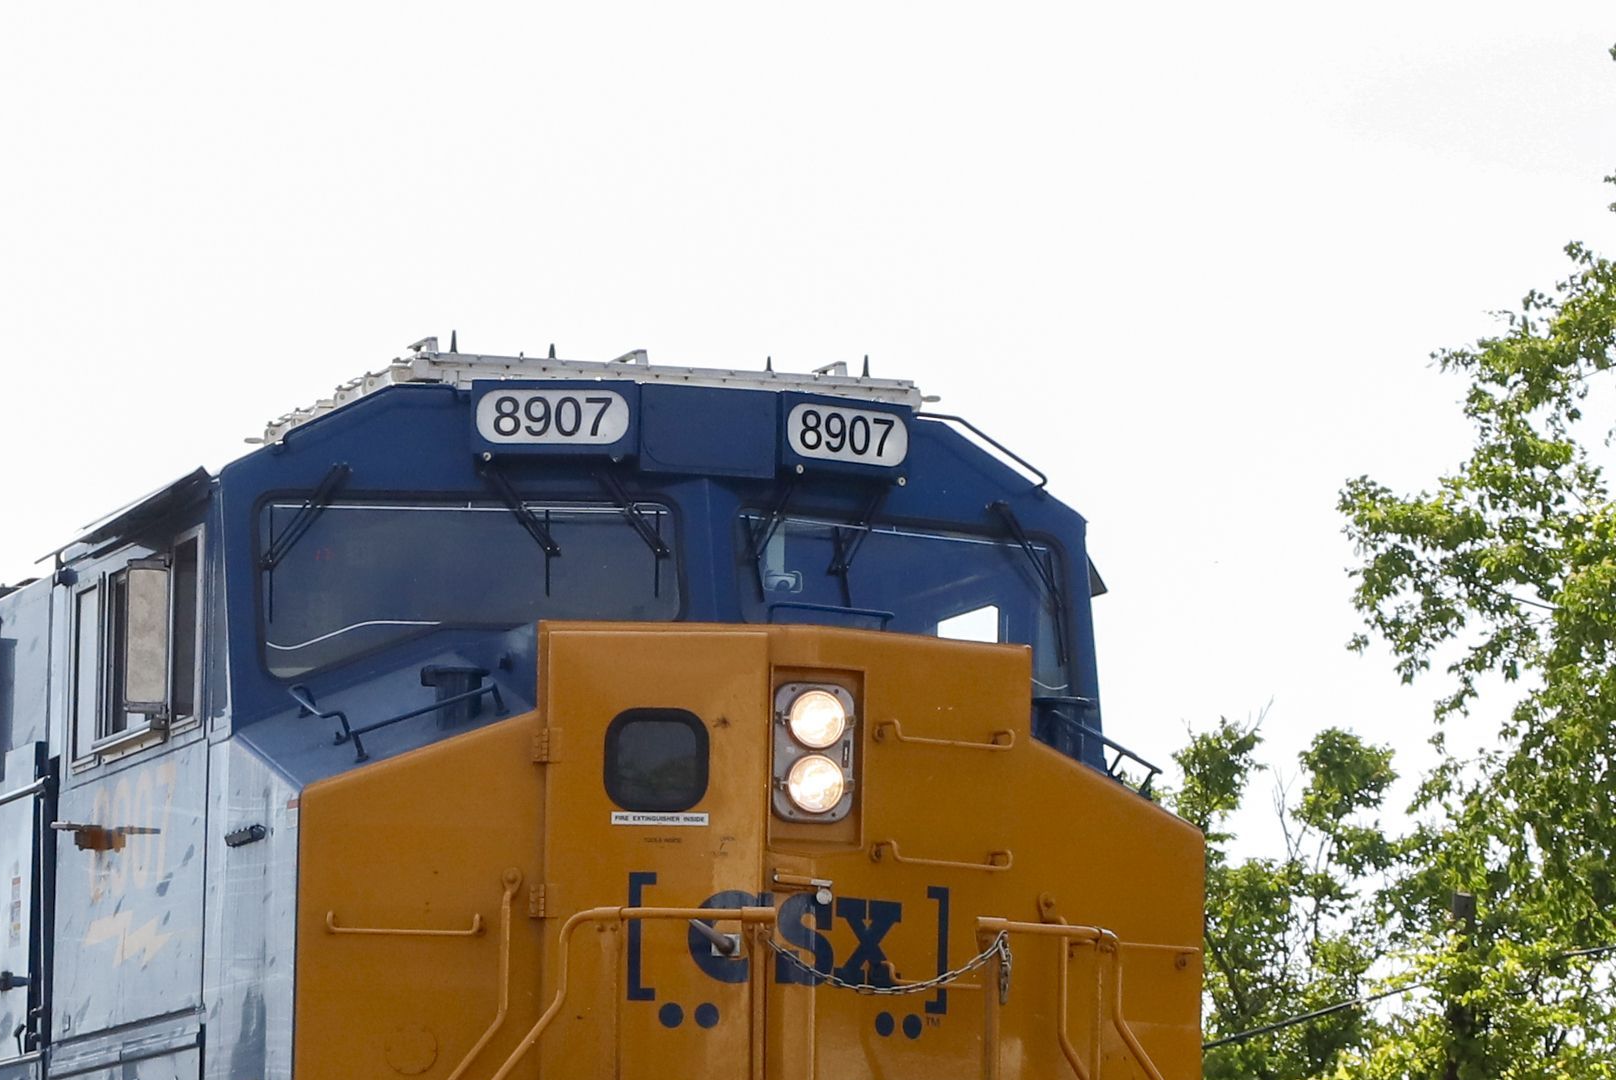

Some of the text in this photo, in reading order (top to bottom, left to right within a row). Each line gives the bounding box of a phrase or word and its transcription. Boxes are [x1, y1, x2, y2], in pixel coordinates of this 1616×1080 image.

[492, 395, 614, 438] 8907
[799, 409, 896, 459] 8907
[687, 888, 903, 987] CSX
[926, 1015, 942, 1028] TM
